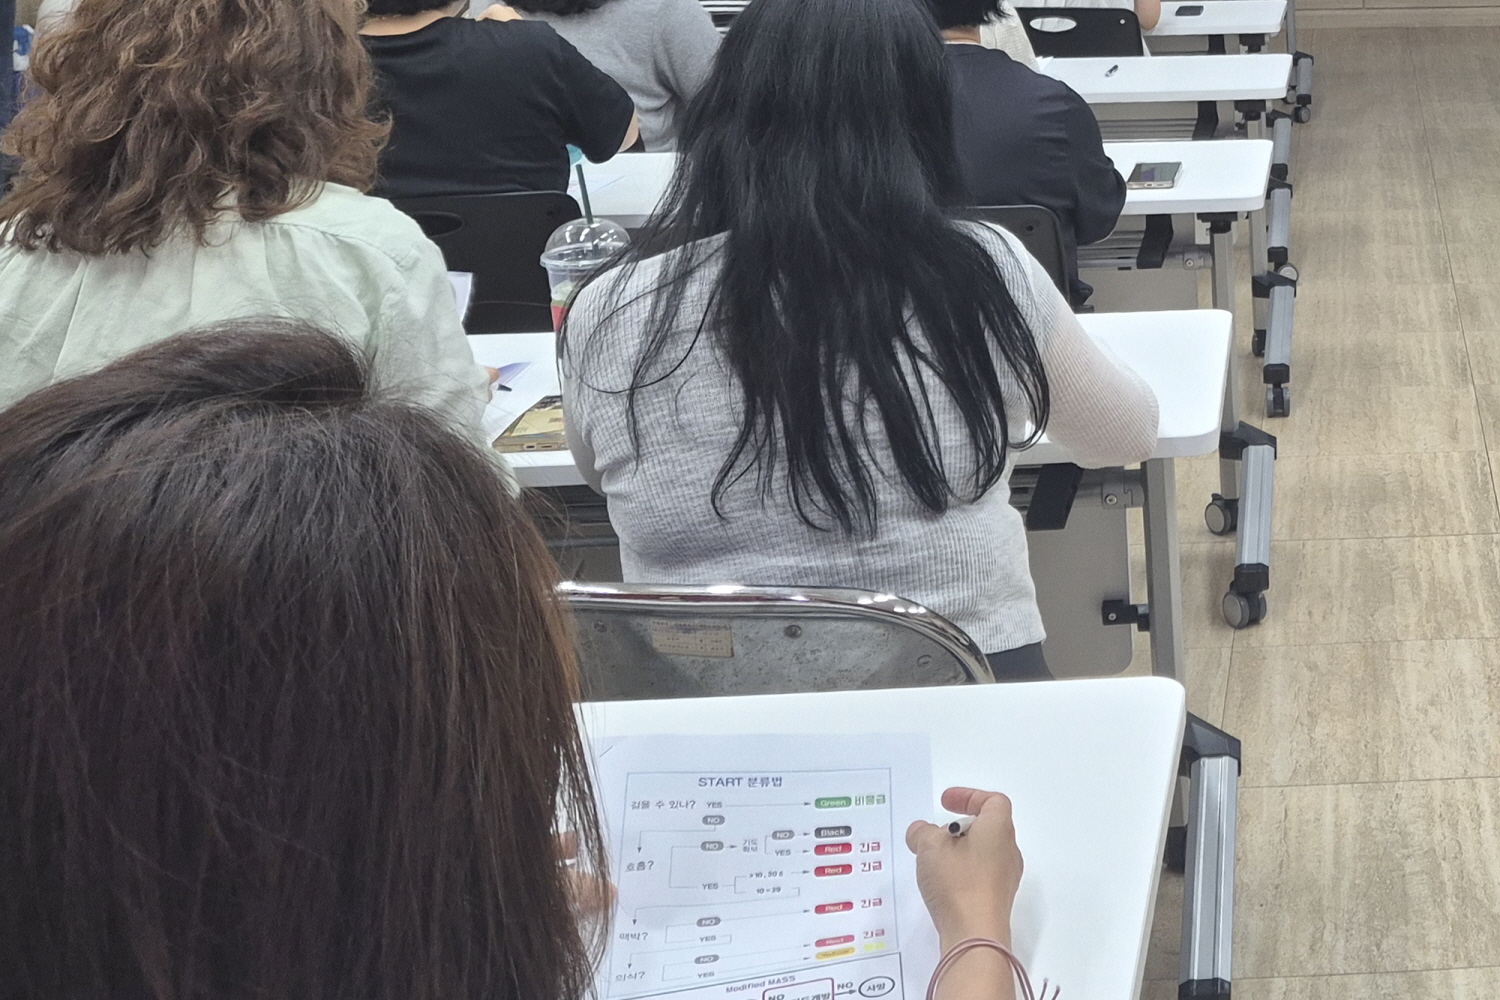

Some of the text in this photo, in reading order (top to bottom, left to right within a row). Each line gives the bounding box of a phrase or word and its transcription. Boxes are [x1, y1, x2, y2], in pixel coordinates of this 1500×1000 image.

[698, 776, 783, 788] START 분류법
[655, 801, 665, 810] 수
[668, 800, 696, 810] 있나?
[706, 801, 723, 809] YES
[820, 799, 847, 807] Green
[855, 794, 886, 806] 비응급
[820, 828, 846, 837] Black
[824, 845, 842, 853] Red
[859, 841, 881, 853] 긴급
[774, 849, 791, 857] YES
[625, 860, 655, 872] 호흡?
[824, 866, 843, 875] Red
[861, 860, 883, 873] 긴급
[825, 903, 843, 912] Red
[860, 897, 883, 909] 긴급
[619, 931, 649, 941] 맥박?
[863, 929, 886, 939] 긴급
[615, 971, 646, 982] 의식?
[697, 971, 715, 979] YES
[725, 975, 796, 993] Modified MASS
[837, 981, 854, 991] NO
[866, 982, 886, 992] 사망
